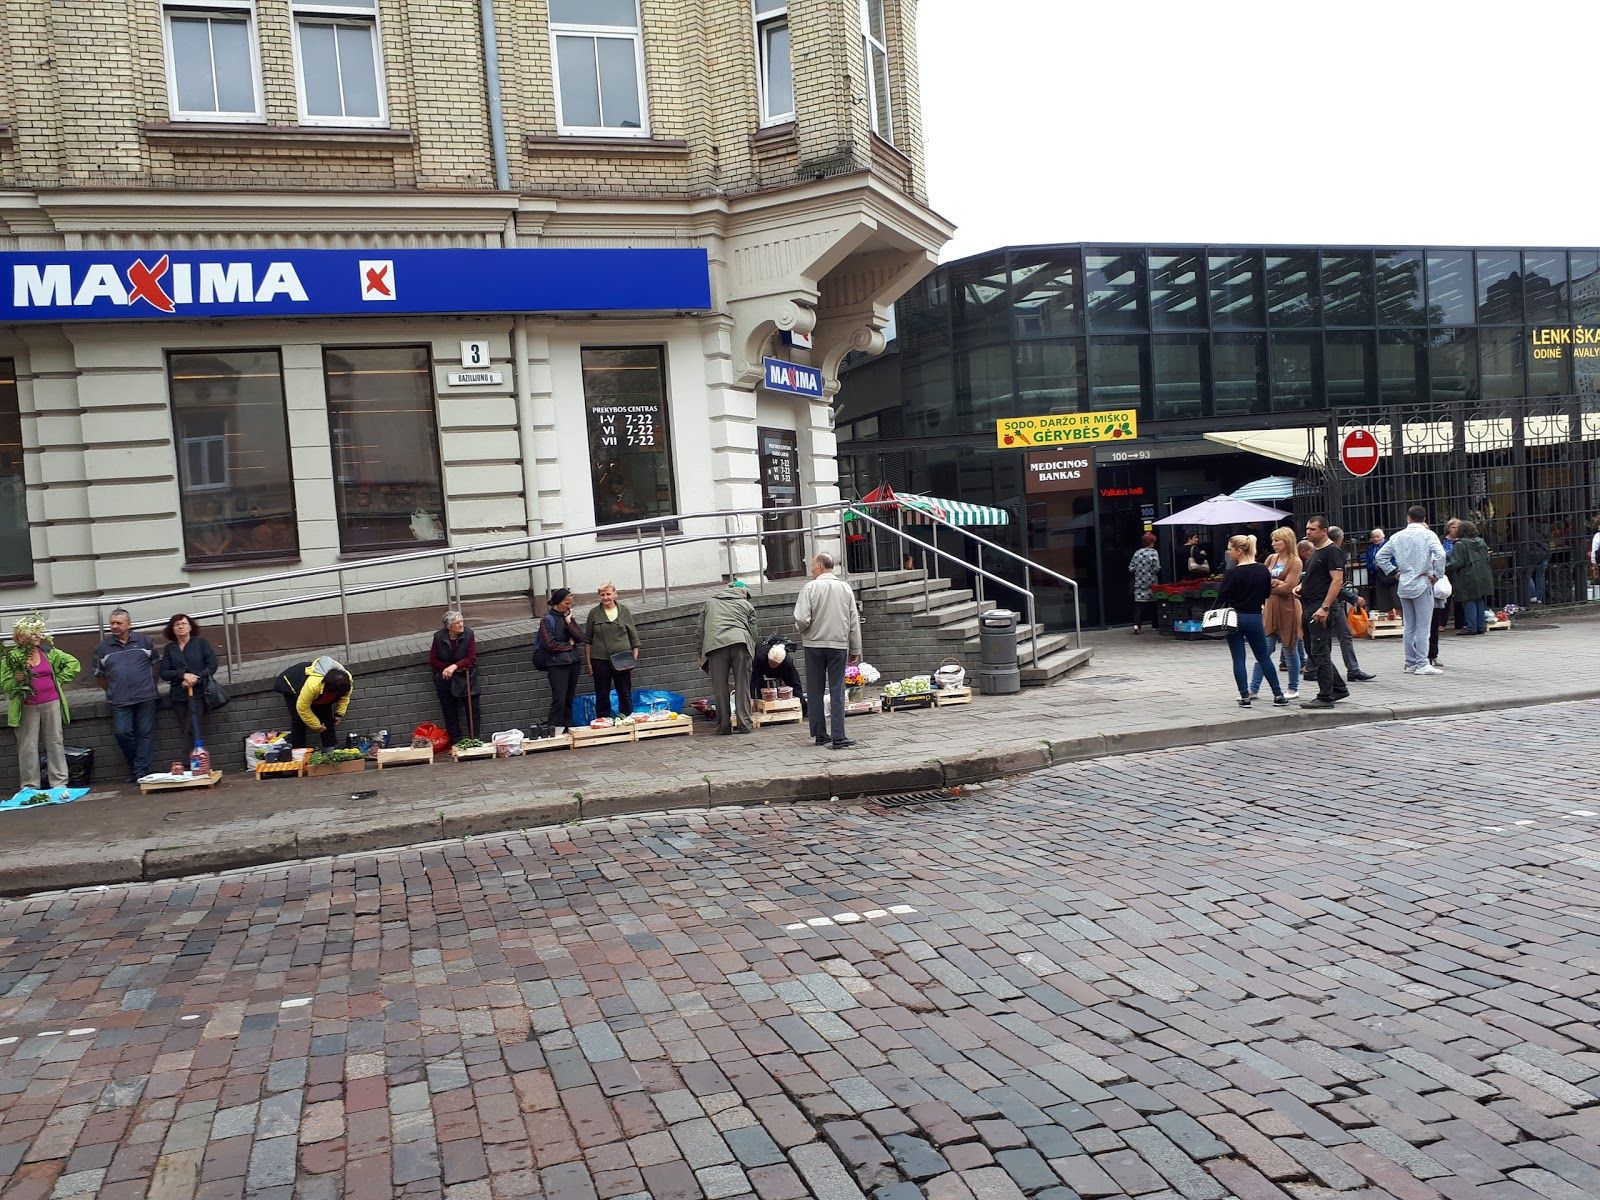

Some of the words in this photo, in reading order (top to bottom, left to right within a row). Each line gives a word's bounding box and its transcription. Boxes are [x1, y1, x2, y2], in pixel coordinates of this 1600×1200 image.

[13, 254, 309, 312] MAXIMA
[471, 344, 480, 364] 3
[1533, 346, 1562, 359] ODINĖ
[770, 365, 818, 391] MAXIMA
[627, 405, 658, 413] CENTRAS
[600, 415, 615, 424] I-V
[625, 414, 653, 425] 7-22
[1004, 420, 1037, 431] SODO,
[1040, 417, 1076, 428] DARŽO
[1080, 416, 1090, 424] IR
[1094, 413, 1129, 424] MIŠKO
[603, 426, 615, 435] VI
[626, 425, 654, 435] 7-22
[1033, 426, 1100, 443] GĖRYBĖS
[602, 437, 618, 446] VII
[627, 436, 655, 446] 7-22
[1111, 452, 1127, 461] 100
[1138, 451, 1151, 460] 93
[1030, 459, 1088, 471] MEDICINOS
[1039, 470, 1081, 482] BANKAS
